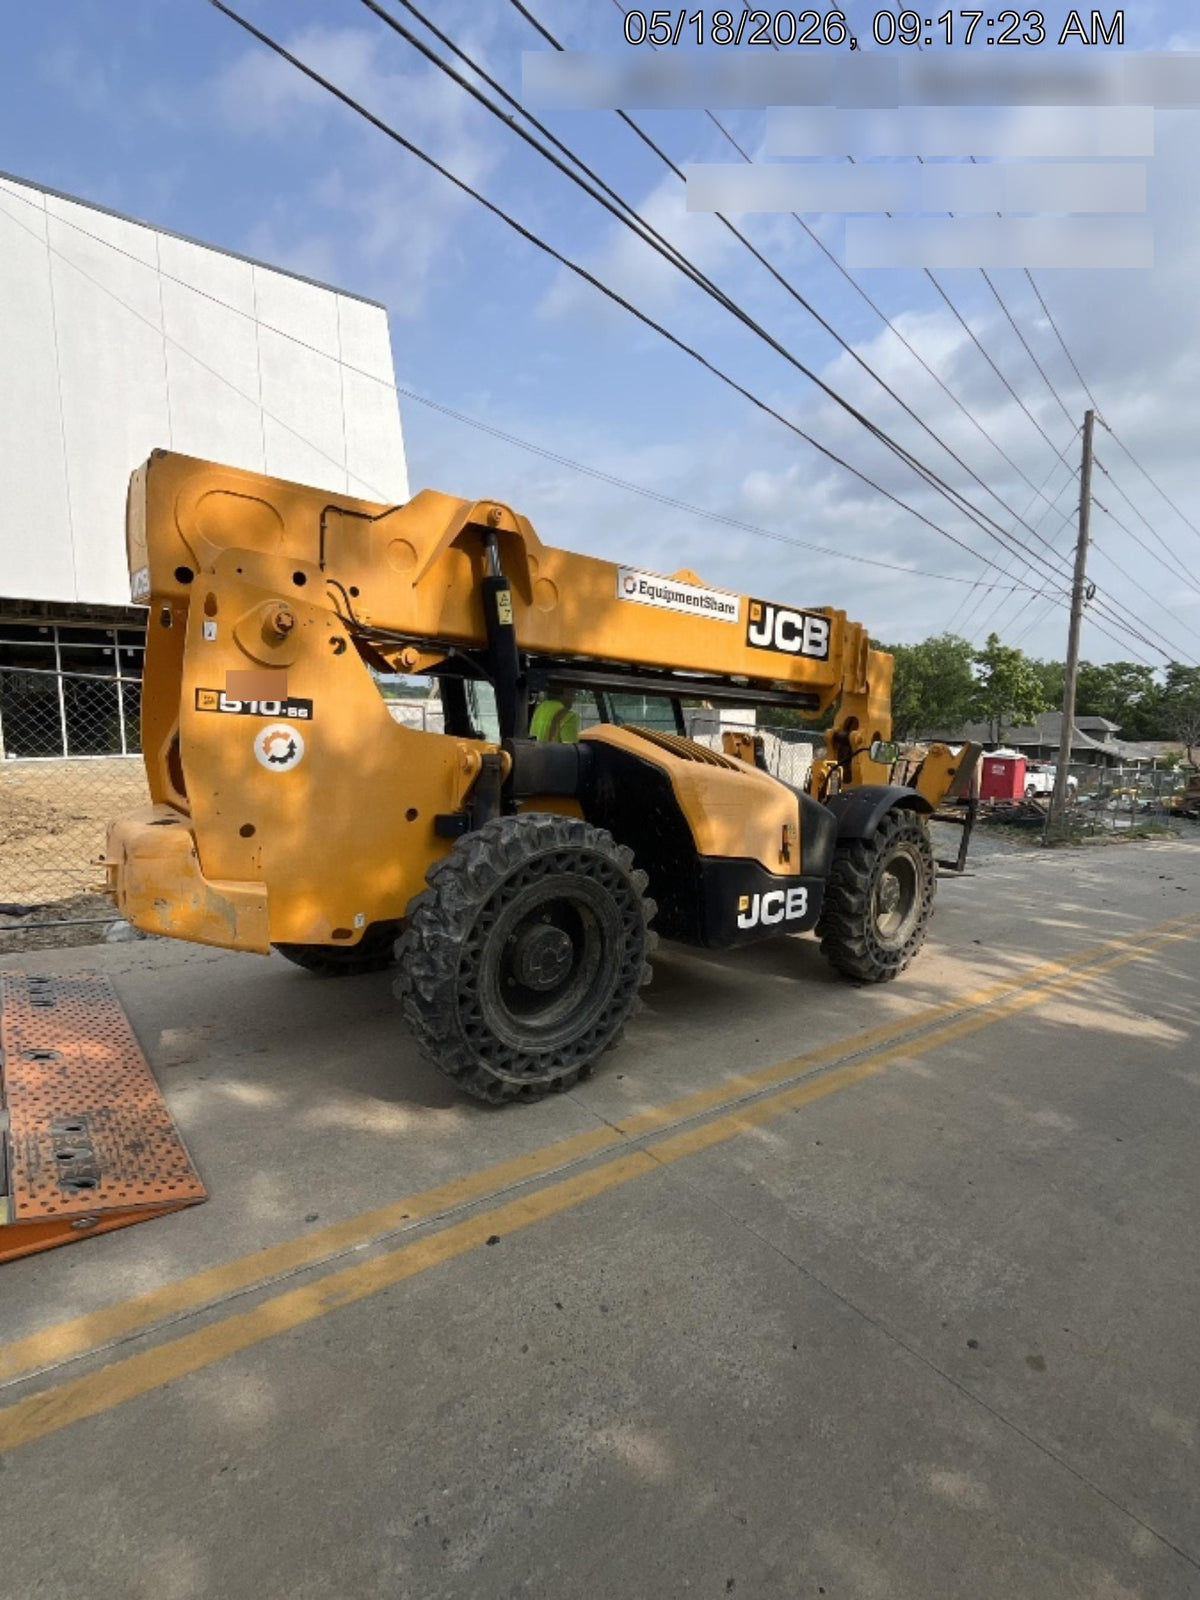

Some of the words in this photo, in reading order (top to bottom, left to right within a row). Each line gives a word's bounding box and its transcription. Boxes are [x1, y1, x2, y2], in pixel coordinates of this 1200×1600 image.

[639, 580, 735, 614] EquipmentShare
[749, 606, 828, 656] JCB
[737, 886, 808, 929] JCB
